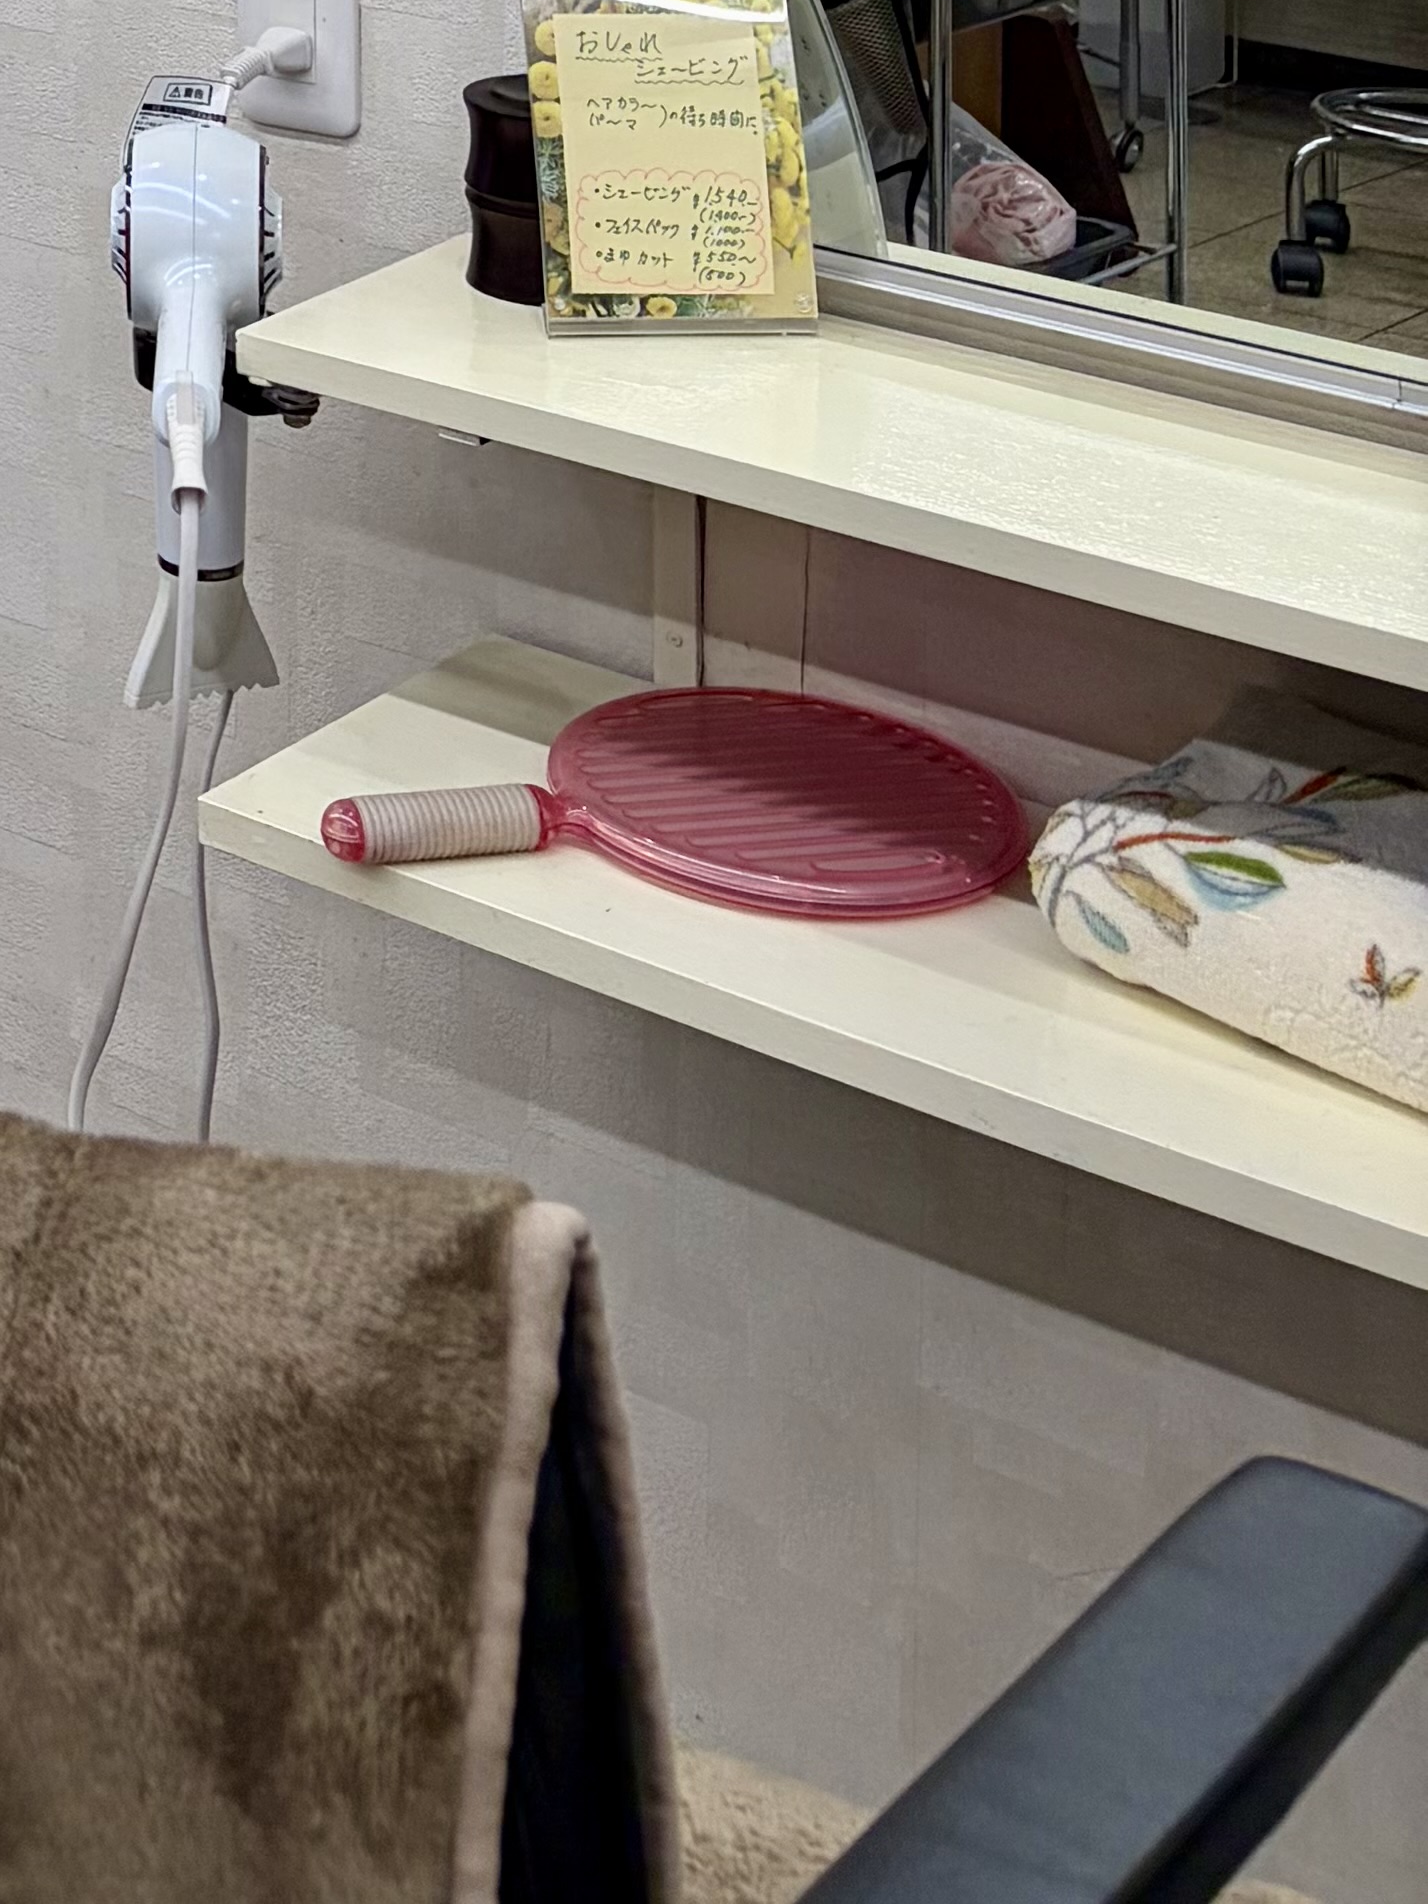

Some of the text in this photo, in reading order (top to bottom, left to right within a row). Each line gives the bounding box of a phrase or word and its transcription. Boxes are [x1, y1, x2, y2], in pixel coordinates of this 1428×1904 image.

[575, 30, 663, 56] おしゃれ
[636, 55, 749, 81] シェービング
[589, 113, 638, 131] パーマ
